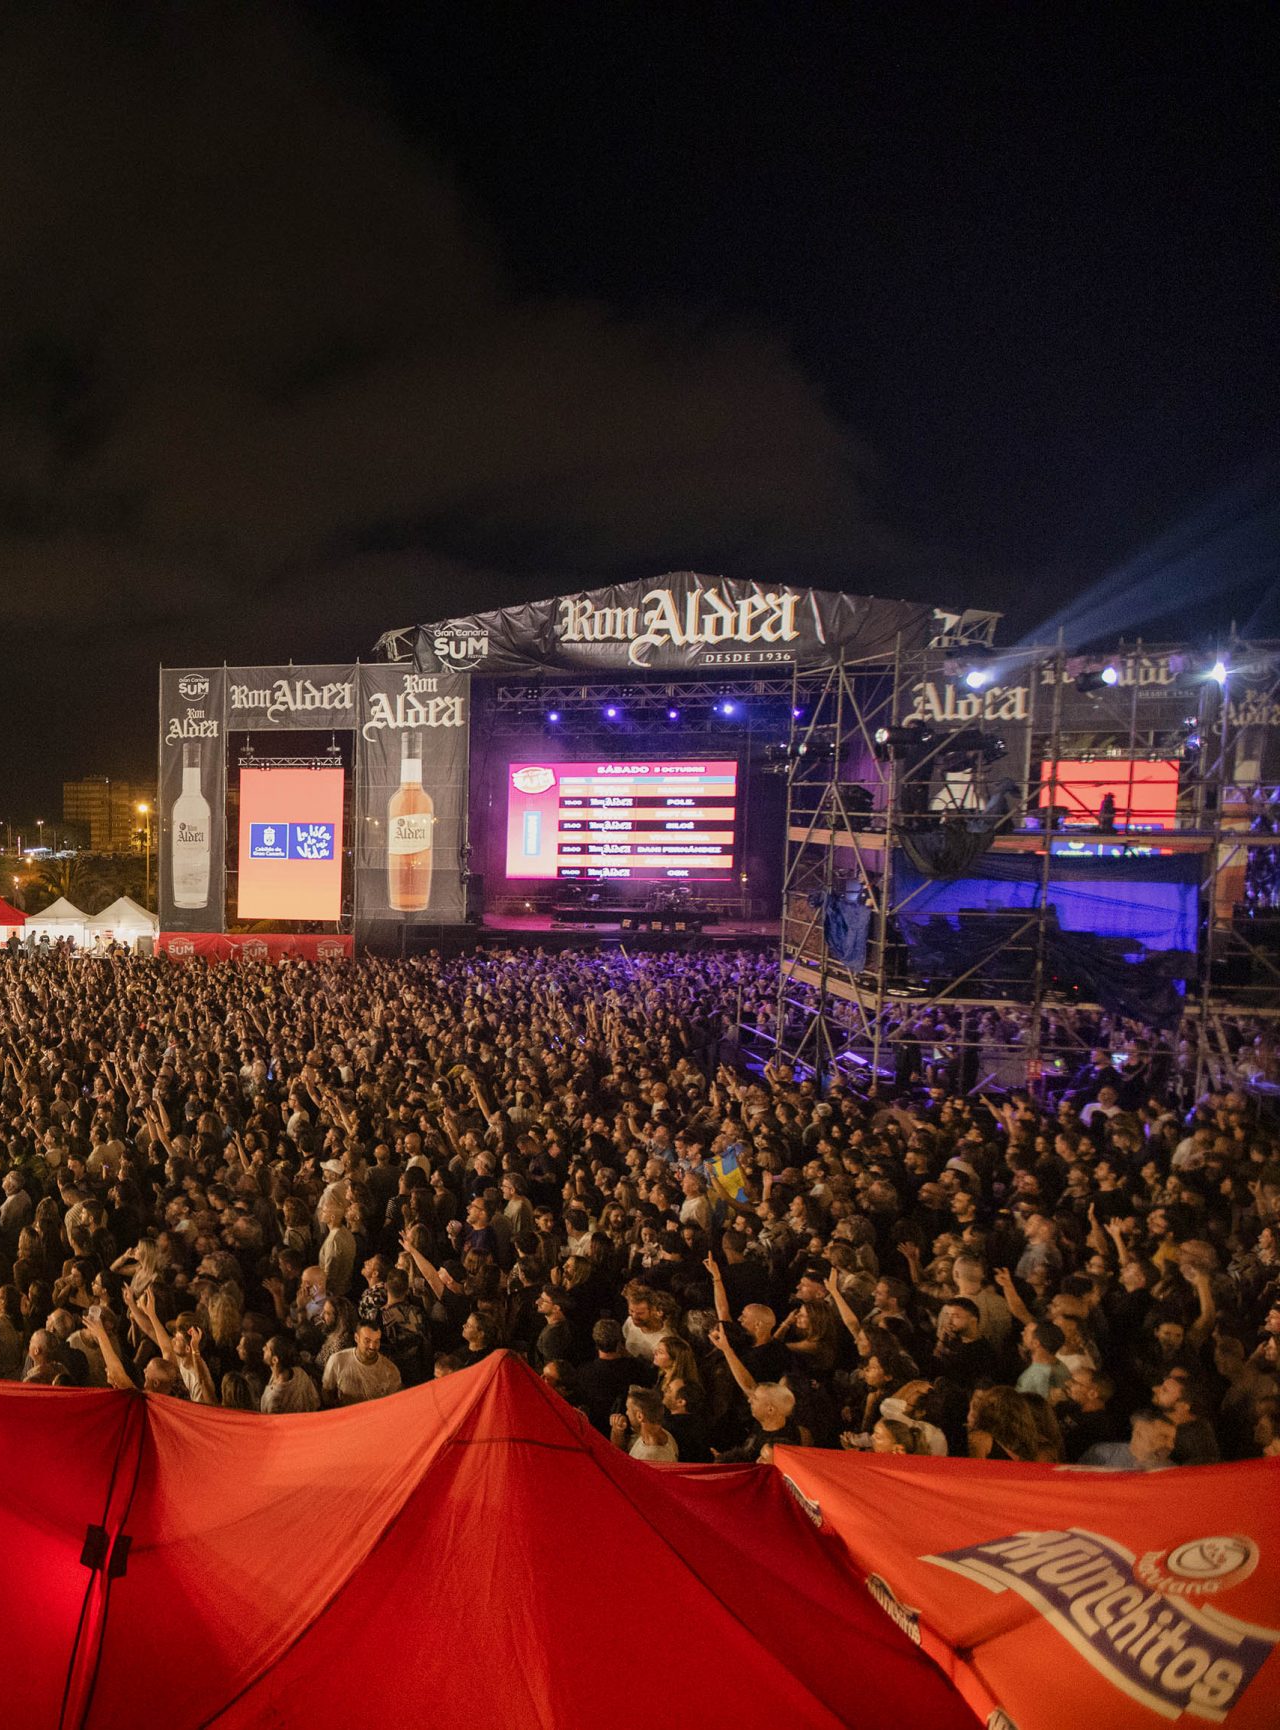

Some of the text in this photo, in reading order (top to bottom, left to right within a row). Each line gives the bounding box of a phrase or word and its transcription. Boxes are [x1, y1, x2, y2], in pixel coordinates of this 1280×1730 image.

[434, 629, 489, 637] Gran Canaria
[559, 588, 801, 667] Ron Aldea
[433, 637, 489, 659] SUM
[705, 652, 792, 663] DESDE 1936
[179, 683, 209, 695] SUM
[403, 674, 439, 694] Ron
[230, 680, 354, 723] Ron Aldea
[186, 708, 205, 719] Ron
[362, 692, 465, 743] Aldea
[165, 718, 219, 746] Aldea
[597, 765, 649, 774] SÁBADO
[168, 945, 194, 955] SUM
[242, 946, 267, 957] SUM
[317, 947, 344, 957] SUM
[976, 1530, 1243, 1707] Munchitos
